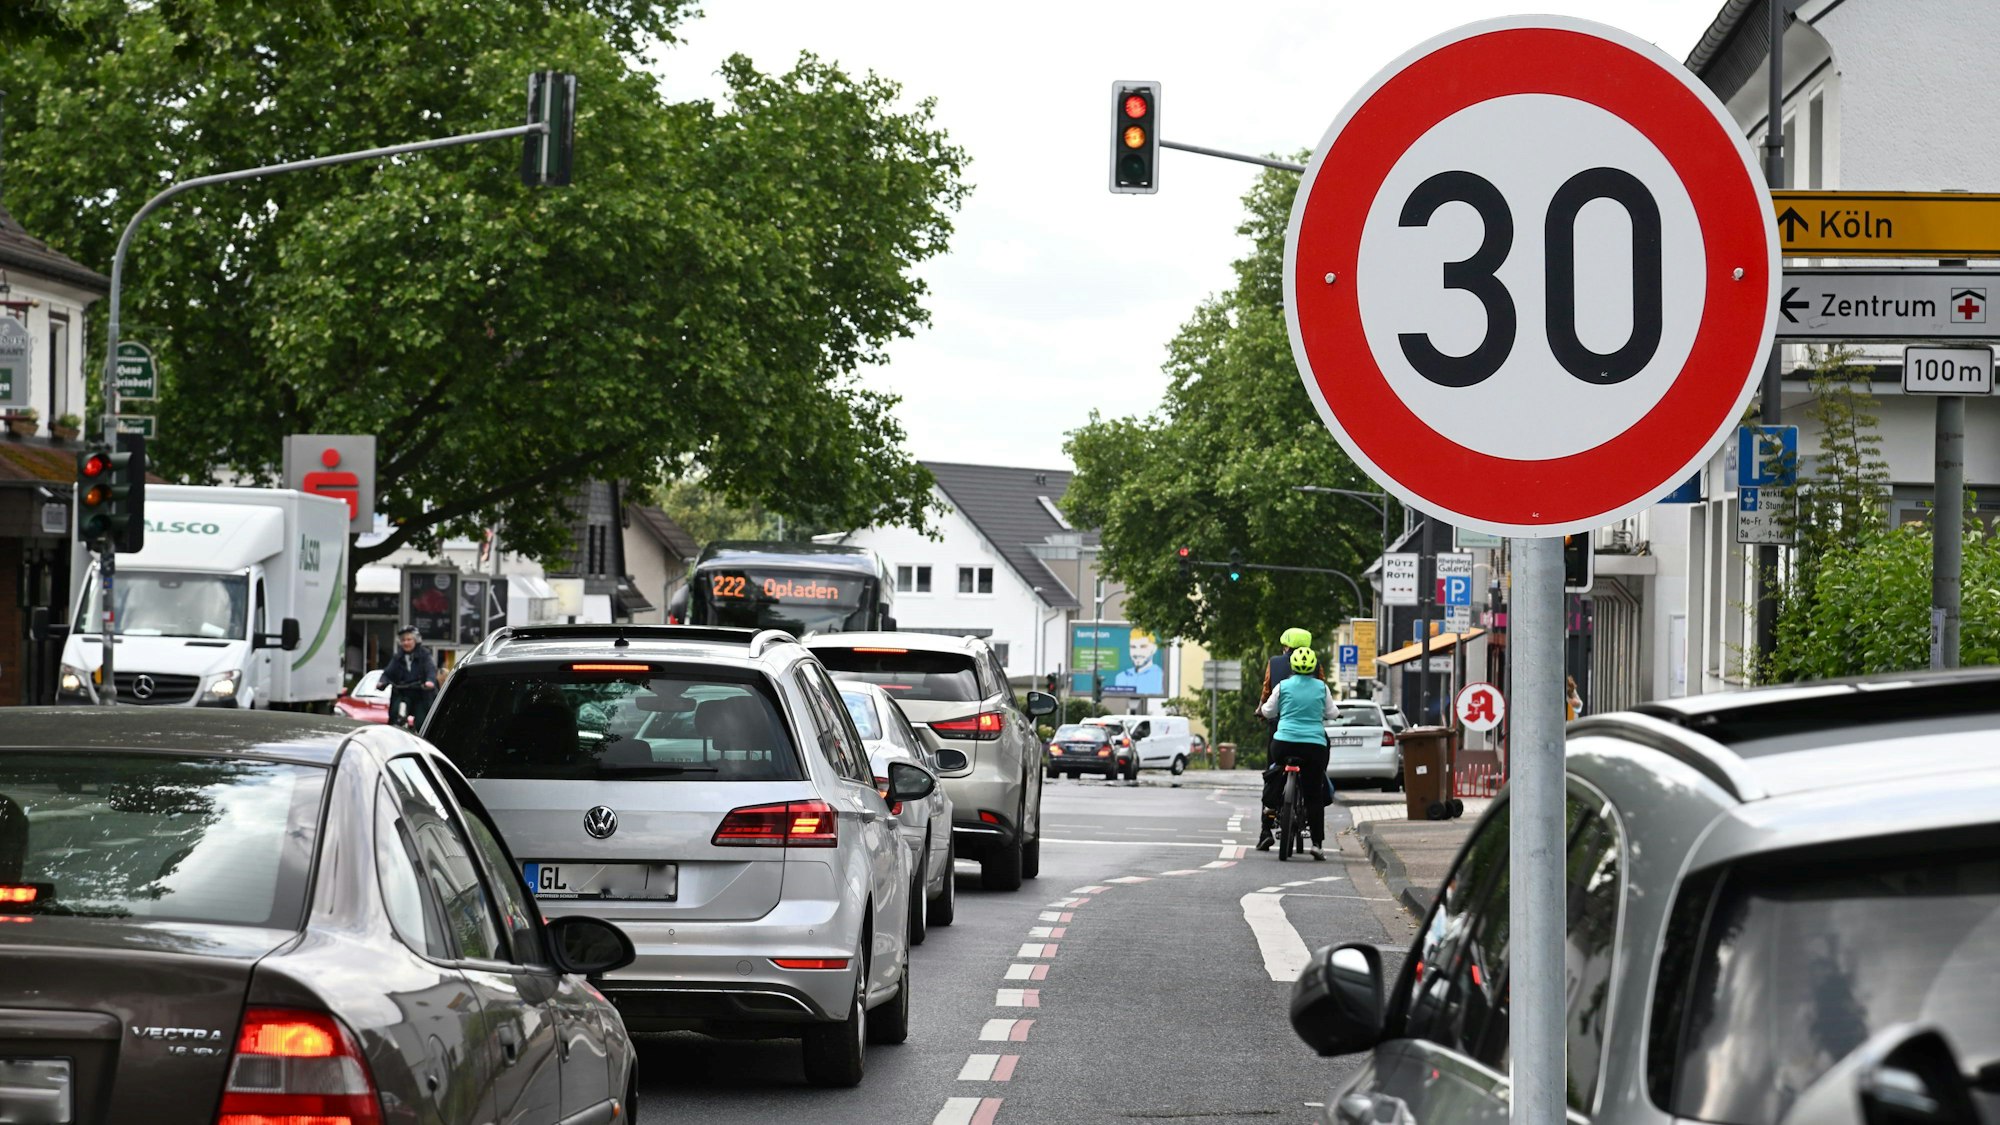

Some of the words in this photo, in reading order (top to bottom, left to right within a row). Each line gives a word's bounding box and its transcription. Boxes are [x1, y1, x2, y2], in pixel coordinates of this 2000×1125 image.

[1820, 210, 1893, 239] Köln
[1398, 166, 1663, 388] 30
[1821, 293, 1936, 317] Zentrum
[1758, 501, 1763, 510] 2
[1740, 517, 1762, 526] Mo-Fr
[1740, 529, 1749, 538] Sa
[1387, 558, 1414, 568] PÜTZ
[1438, 563, 1472, 573] Galerie
[1386, 571, 1415, 579] ROTH
[712, 575, 746, 598] 222
[764, 577, 839, 600] Opladen
[540, 867, 567, 889] GL
[132, 1026, 222, 1040] VECTRA
